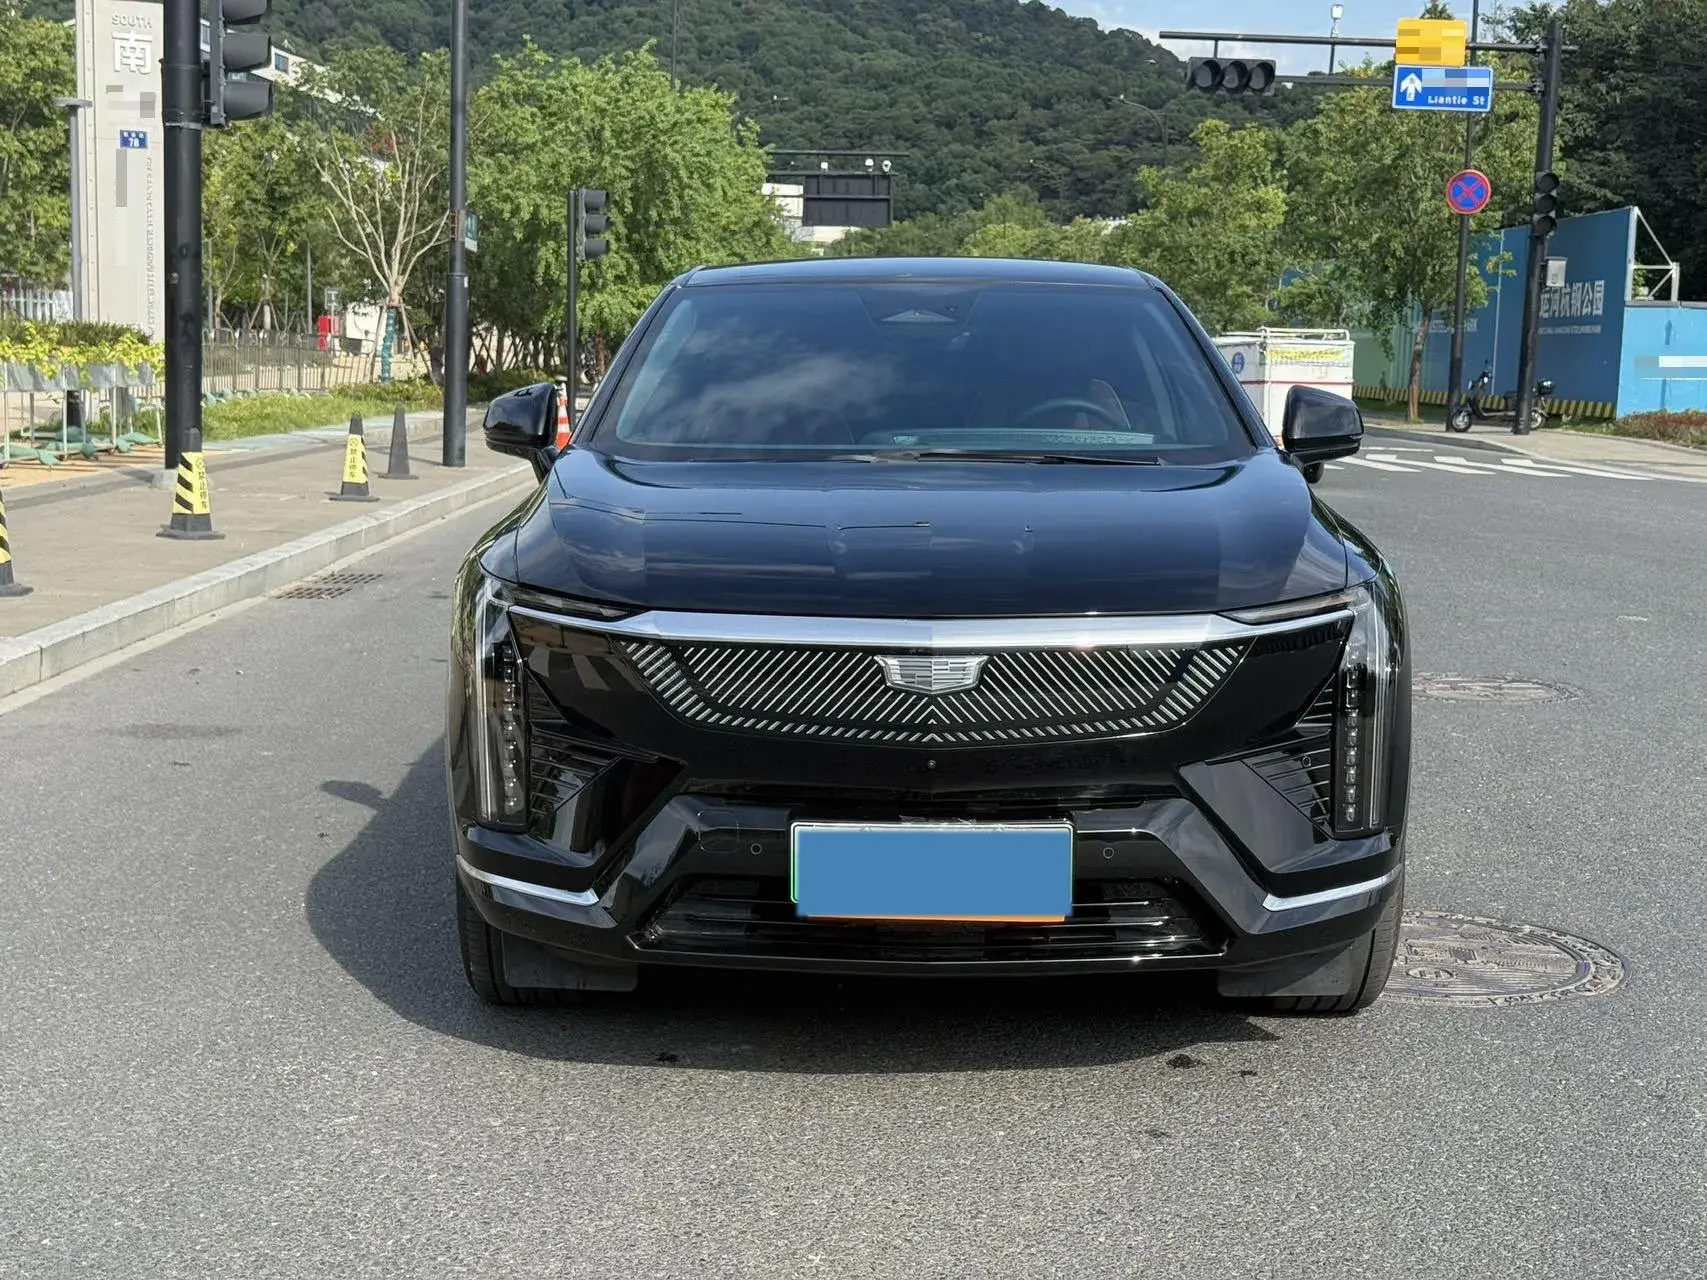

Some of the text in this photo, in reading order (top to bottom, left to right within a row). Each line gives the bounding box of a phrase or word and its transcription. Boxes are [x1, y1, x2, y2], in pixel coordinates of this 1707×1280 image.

[112, 13, 152, 29] SOUTH
[112, 30, 153, 75] 南
[1427, 95, 1486, 106] Liantie St
[349, 447, 358, 478] 禁止停车
[198, 470, 208, 510] 禁止停车
